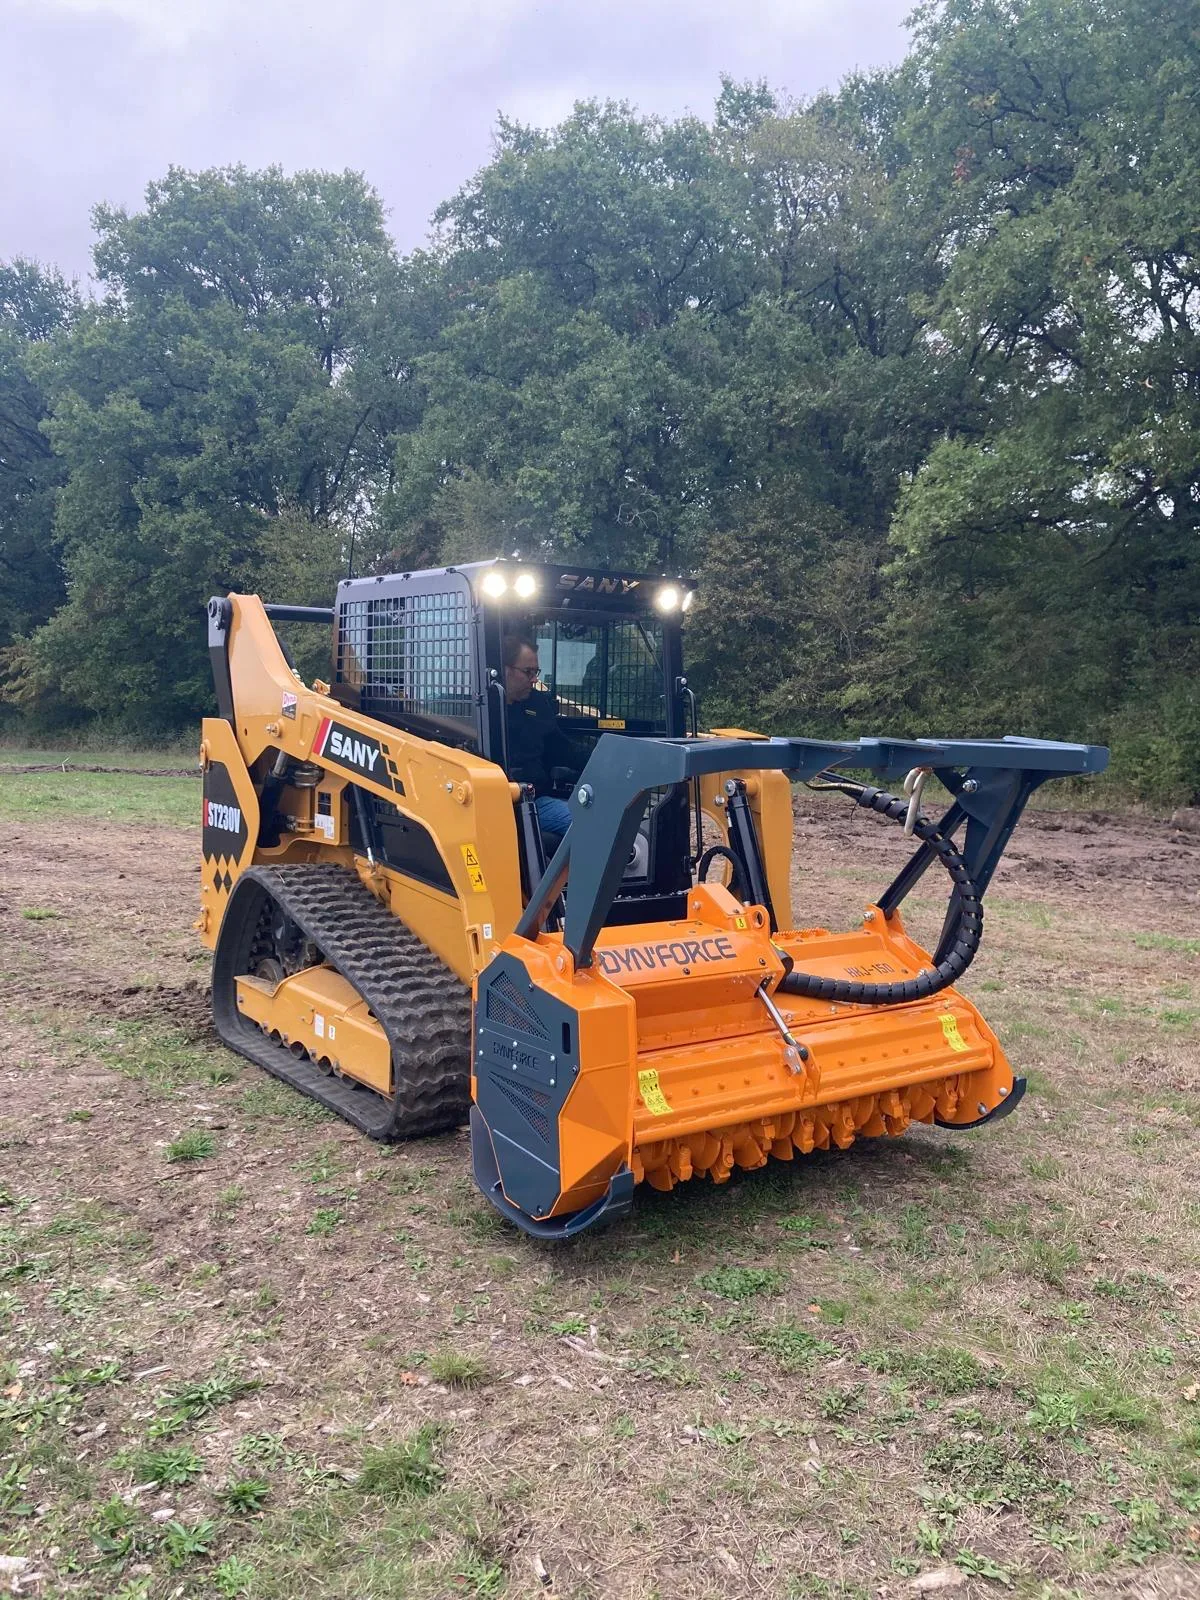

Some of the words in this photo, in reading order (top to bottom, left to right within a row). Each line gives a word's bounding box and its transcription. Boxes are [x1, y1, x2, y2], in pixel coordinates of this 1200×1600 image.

[556, 574, 640, 595] SANY
[330, 731, 379, 771] SANY
[208, 801, 241, 834] ST230V
[599, 937, 737, 974] DYN'FORCE
